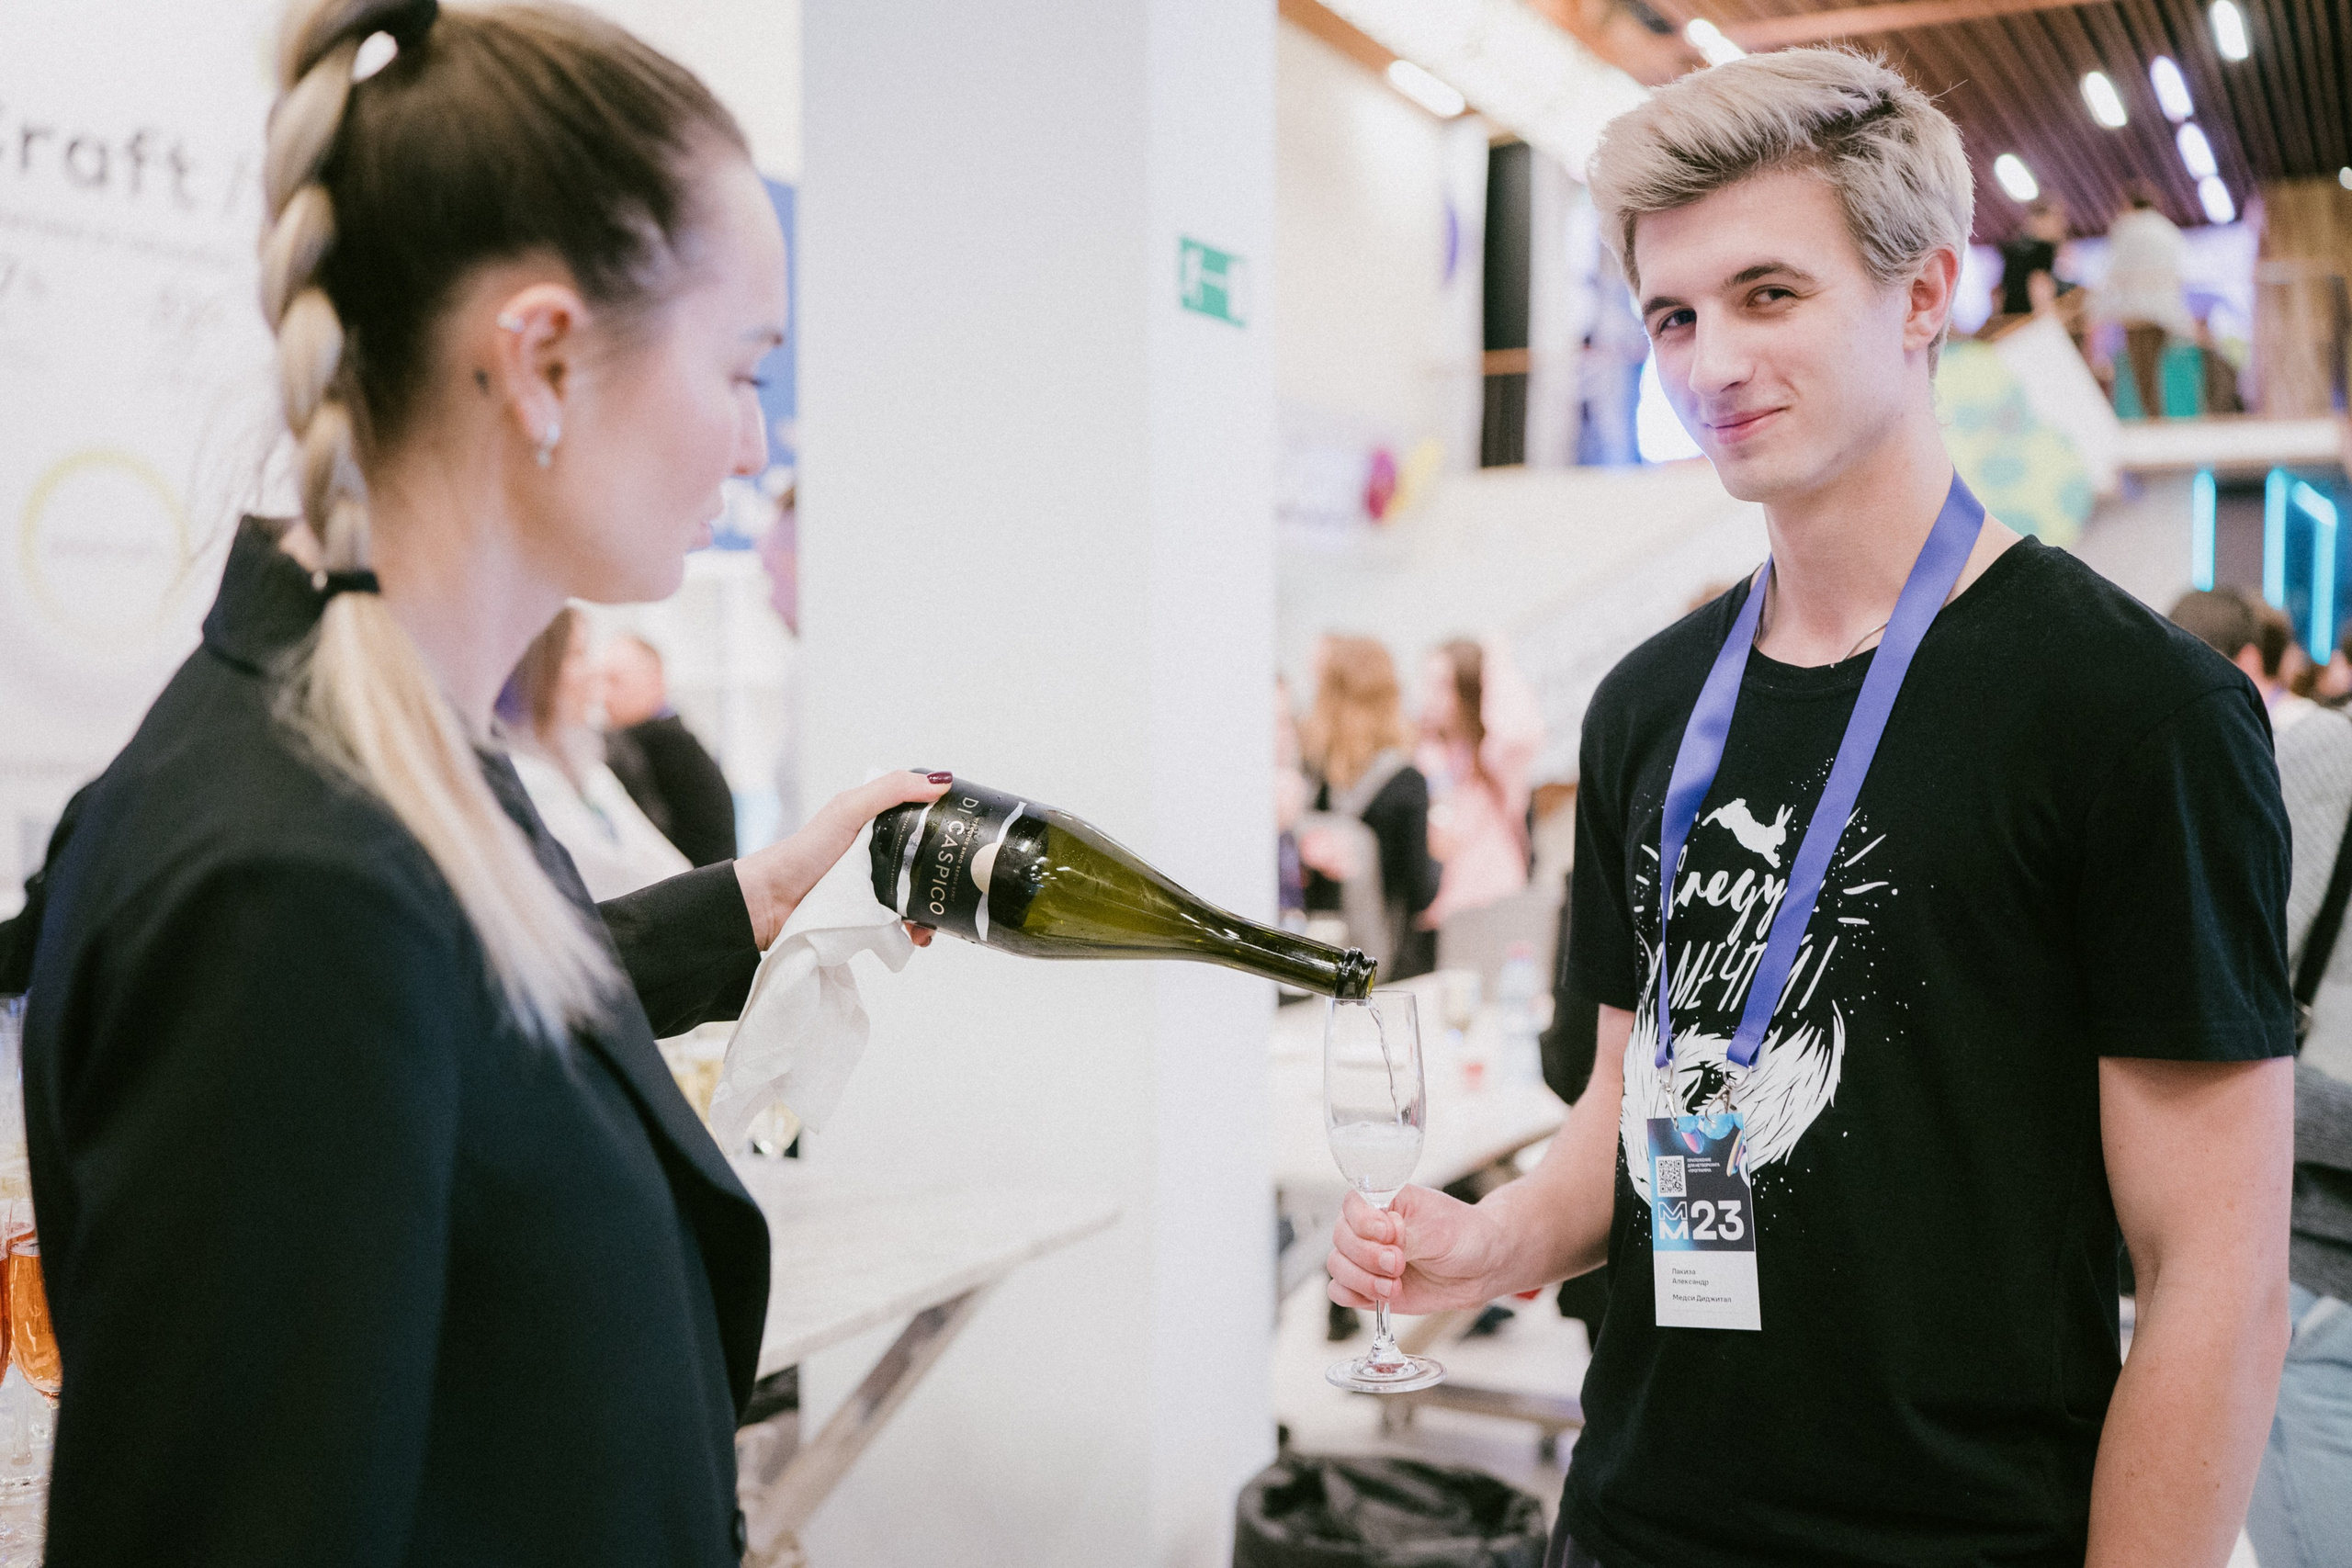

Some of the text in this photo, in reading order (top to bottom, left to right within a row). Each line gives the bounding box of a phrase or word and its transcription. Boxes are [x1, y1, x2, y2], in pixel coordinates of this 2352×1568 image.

[0, 106, 197, 211] raft
[929, 797, 979, 915] DI CASPICO
[1672, 1278, 1710, 1287] Александр
